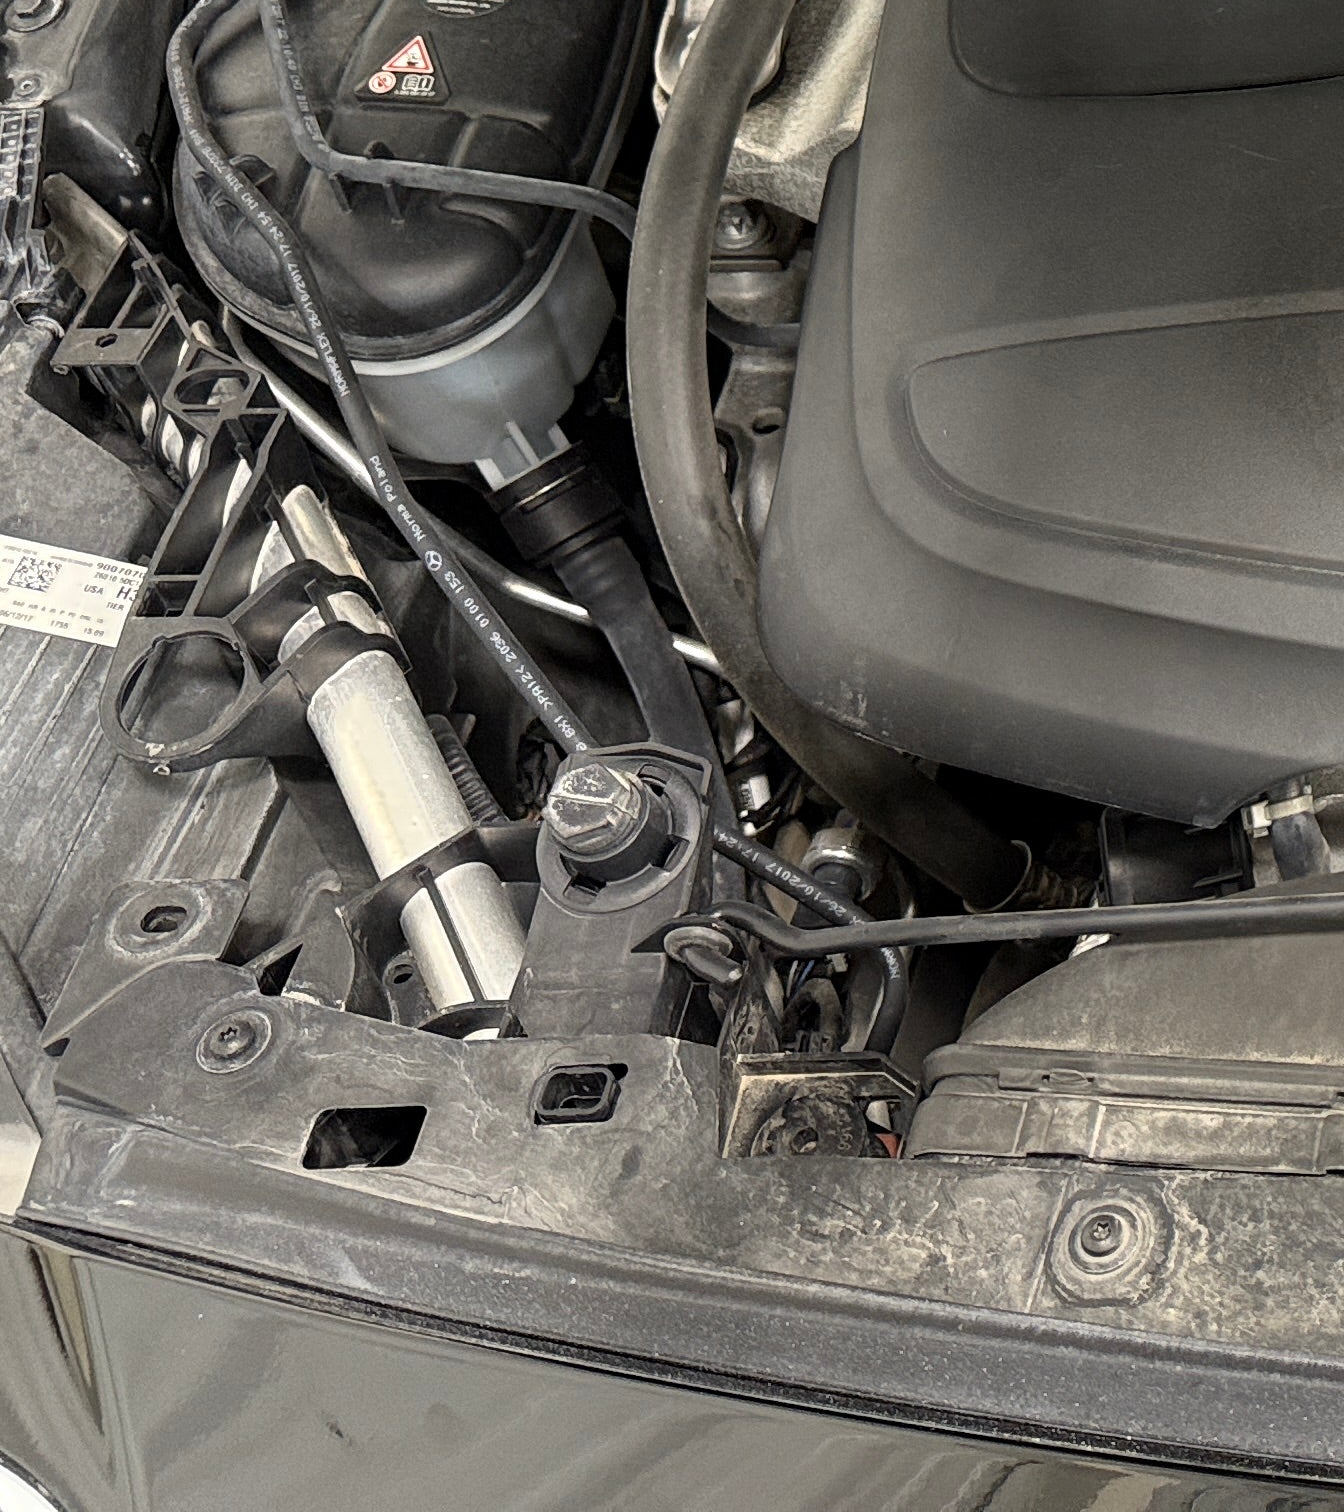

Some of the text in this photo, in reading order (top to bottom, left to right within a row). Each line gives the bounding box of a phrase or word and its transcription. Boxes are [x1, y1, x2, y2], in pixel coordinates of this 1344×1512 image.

[288, 261, 322, 330] 26/10/2017
[369, 454, 398, 502] Poland
[397, 503, 428, 542] Norma
[84, 584, 104, 595] USA
[443, 568, 466, 593] 153
[106, 601, 124, 611] TIER
[464, 596, 489, 628] 0100
[489, 630, 518, 663] 2036
[764, 861, 848, 918] 26/10/2017
